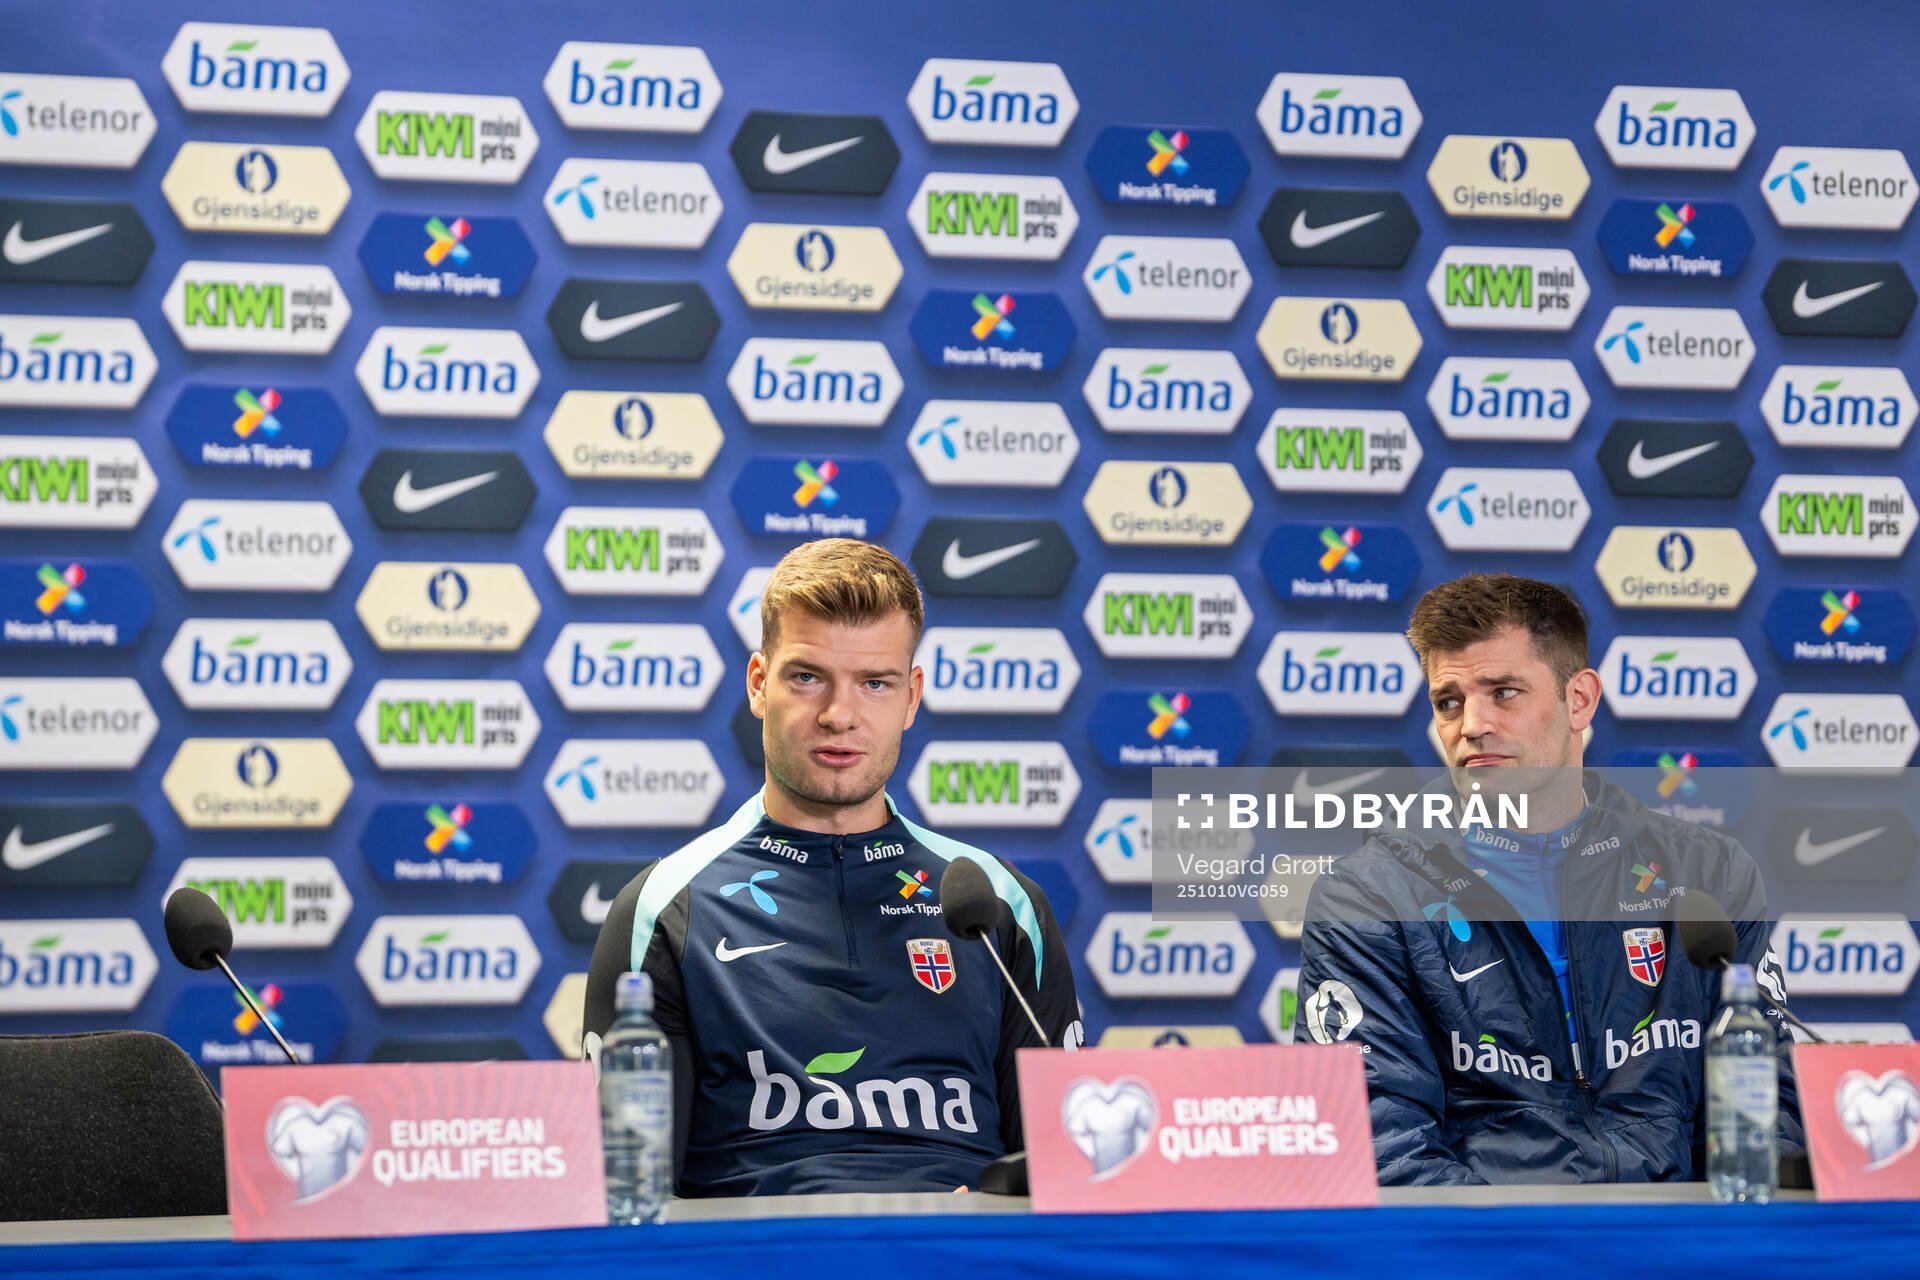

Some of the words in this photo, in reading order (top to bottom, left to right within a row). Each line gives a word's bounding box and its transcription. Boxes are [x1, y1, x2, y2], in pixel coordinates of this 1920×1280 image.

[27, 102, 142, 133] telenor
[481, 117, 521, 139] mini
[376, 111, 474, 159] KIWI
[481, 141, 515, 164] pris
[1119, 183, 1162, 199] Norsk
[1163, 184, 1216, 205] Tipping
[1812, 172, 1908, 198] telenor
[604, 187, 709, 214] telenor
[1024, 196, 1061, 217] mini
[1454, 186, 1563, 211] Gjensidige
[192, 198, 319, 224] Gjensidige
[927, 191, 1018, 237] KIWI
[1024, 218, 1058, 242] pris
[1139, 262, 1239, 288] telenor
[1629, 255, 1670, 271] Norsk
[1671, 256, 1721, 275] Tipping
[395, 271, 440, 290] Norsk
[443, 273, 500, 296] Tipping
[756, 276, 874, 302] Gjensidige
[1446, 264, 1532, 308] KIWI
[1539, 267, 1574, 288] mini
[185, 281, 284, 329] KIWI
[291, 285, 332, 308] mini
[1539, 290, 1570, 312] pris
[291, 311, 326, 334] pris
[1648, 332, 1744, 357] telenor
[944, 347, 988, 365] Norsk
[989, 348, 1043, 369] Tipping
[1284, 348, 1395, 371] Gjensidige
[964, 426, 1066, 454] telenor
[1276, 427, 1363, 470] KIWI
[1370, 429, 1406, 449] mini
[203, 444, 250, 463] Norsk
[253, 445, 311, 468] Tipping
[574, 445, 694, 470] Gjensidige
[1370, 452, 1402, 475] pris
[0, 456, 88, 502] KIWI
[96, 460, 138, 482] mini
[96, 484, 132, 506] pris
[1481, 492, 1579, 519] telenor
[1869, 495, 1903, 516] mini
[765, 513, 810, 532] Norsk
[811, 515, 866, 537] Tipping
[1779, 492, 1862, 535] KIWI
[1111, 514, 1224, 538] Gjensidige
[1869, 519, 1899, 539] pris
[226, 529, 336, 556] telenor
[566, 527, 660, 571] KIWI
[667, 530, 706, 551] mini
[667, 554, 700, 575] pris
[1292, 579, 1335, 596] Norsk
[1336, 580, 1388, 600] Tipping
[1622, 577, 1729, 600] Gjensidige
[1104, 593, 1193, 637] KIWI
[1200, 594, 1237, 615] mini
[4, 620, 54, 640] Norsk
[56, 620, 117, 645] Tipping
[386, 615, 509, 638] Gjensidige
[1200, 618, 1232, 640] pris
[1794, 642, 1835, 658] Norsk
[1836, 644, 1887, 663] Tipping
[27, 703, 141, 734] telenor
[378, 700, 474, 744] KIWI
[482, 701, 522, 722] mini
[482, 724, 516, 747] pris
[1814, 718, 1909, 744] telenor
[1120, 746, 1164, 764] Norsk
[1165, 747, 1218, 767] Tipping
[604, 768, 709, 794] telenor
[929, 760, 1019, 804] KIWI
[1025, 764, 1062, 785] mini
[194, 794, 321, 816] Gjensidige
[1025, 786, 1059, 807] pris
[1141, 822, 1239, 851] telenor
[395, 860, 442, 878] Norsk
[444, 861, 501, 883] Tipping
[187, 879, 284, 922] IWI
[294, 881, 334, 900] mini
[294, 905, 328, 925] pris
[880, 904, 914, 916] Norsk
[915, 903, 943, 916] Tippi
[1619, 901, 1651, 913] Norsk
[747, 1046, 979, 1134] bama
[1174, 1095, 1317, 1126] EUROPEAN
[390, 1118, 543, 1148] EUROPEAN
[1159, 1123, 1339, 1163] QUALIFIERS
[372, 1146, 566, 1184] QUALIFIERS
